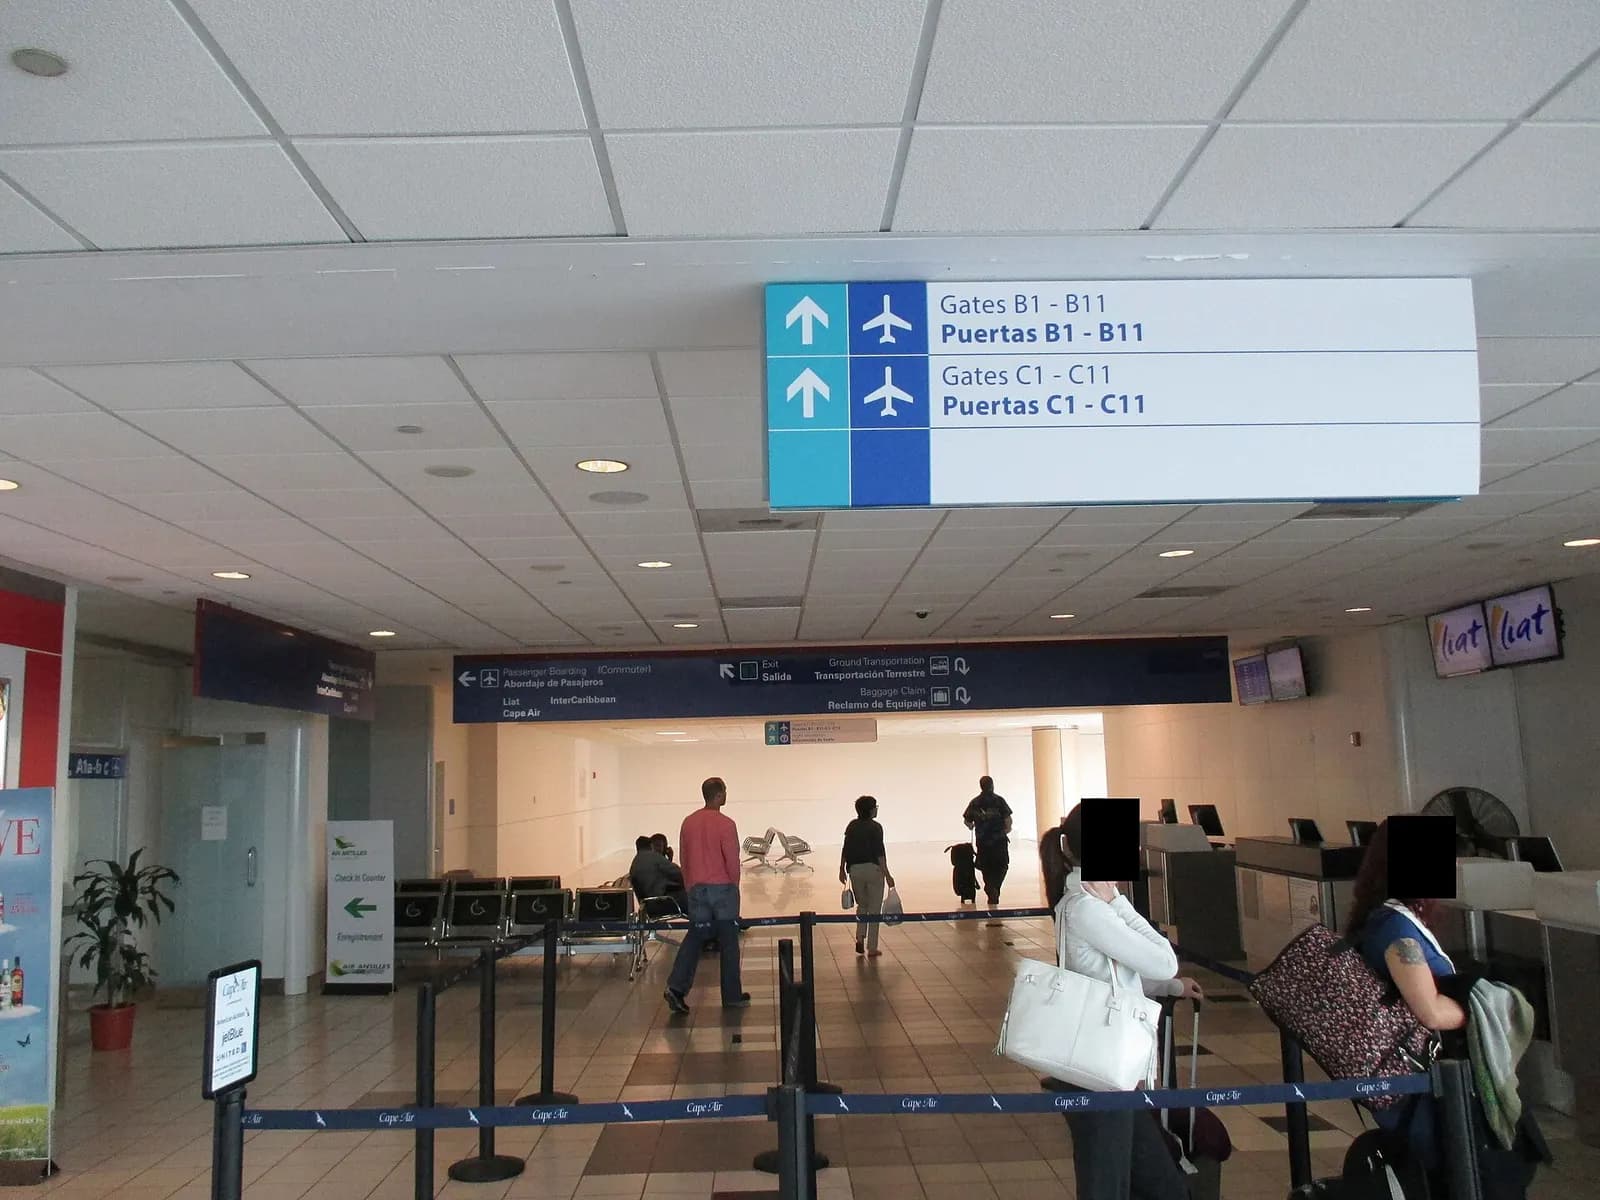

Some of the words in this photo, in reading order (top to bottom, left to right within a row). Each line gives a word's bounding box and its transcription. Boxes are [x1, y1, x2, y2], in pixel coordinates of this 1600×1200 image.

[940, 294, 1006, 315] Gates
[1014, 294, 1040, 314] B1
[1066, 294, 1106, 314] B11
[941, 324, 1038, 344] Puertas
[1045, 323, 1074, 343] B1
[1099, 322, 1144, 342] B11
[942, 366, 1009, 386] Gates
[1016, 365, 1043, 385] C1
[1068, 364, 1110, 385] C11
[943, 395, 1040, 416] Puertas
[1046, 394, 1075, 415] C1
[1100, 394, 1145, 414] C11
[1501, 603, 1550, 650] liat
[1442, 619, 1483, 663] liat
[762, 660, 778, 669] Exit
[829, 658, 862, 668] Ground
[863, 656, 925, 668] Transportation
[503, 667, 547, 678] Passenger
[549, 667, 587, 677] Boarding
[598, 665, 651, 676] (Commuter)
[762, 671, 792, 682] Salida
[814, 670, 885, 681] Transportación
[885, 668, 926, 679] Terrestre
[504, 679, 545, 690] Abordaje
[547, 679, 559, 687] de
[561, 678, 604, 688] Pasajeros
[860, 687, 899, 698] Baggage
[901, 686, 926, 696] Claim
[550, 696, 616, 705] InterCaribbean
[828, 700, 870, 711] Reclamo
[871, 700, 885, 709] de
[886, 699, 927, 711] Equipaje
[503, 709, 526, 719] Cape
[527, 708, 541, 718] Air
[1356, 1082, 1375, 1095] Cape
[1376, 1080, 1391, 1092] Air
[901, 1096, 921, 1109] Cape
[922, 1096, 937, 1108] Air
[1054, 1095, 1074, 1108] Cape
[1075, 1095, 1090, 1106] Air
[1206, 1090, 1225, 1103] Cape
[1227, 1090, 1241, 1100] Air
[532, 1108, 553, 1123] Cape
[554, 1108, 568, 1120] Air
[686, 1101, 707, 1117] Cape
[708, 1101, 722, 1113] Air
[248, 1113, 263, 1124] Air
[379, 1112, 399, 1126] Cape
[400, 1111, 415, 1122] Air
